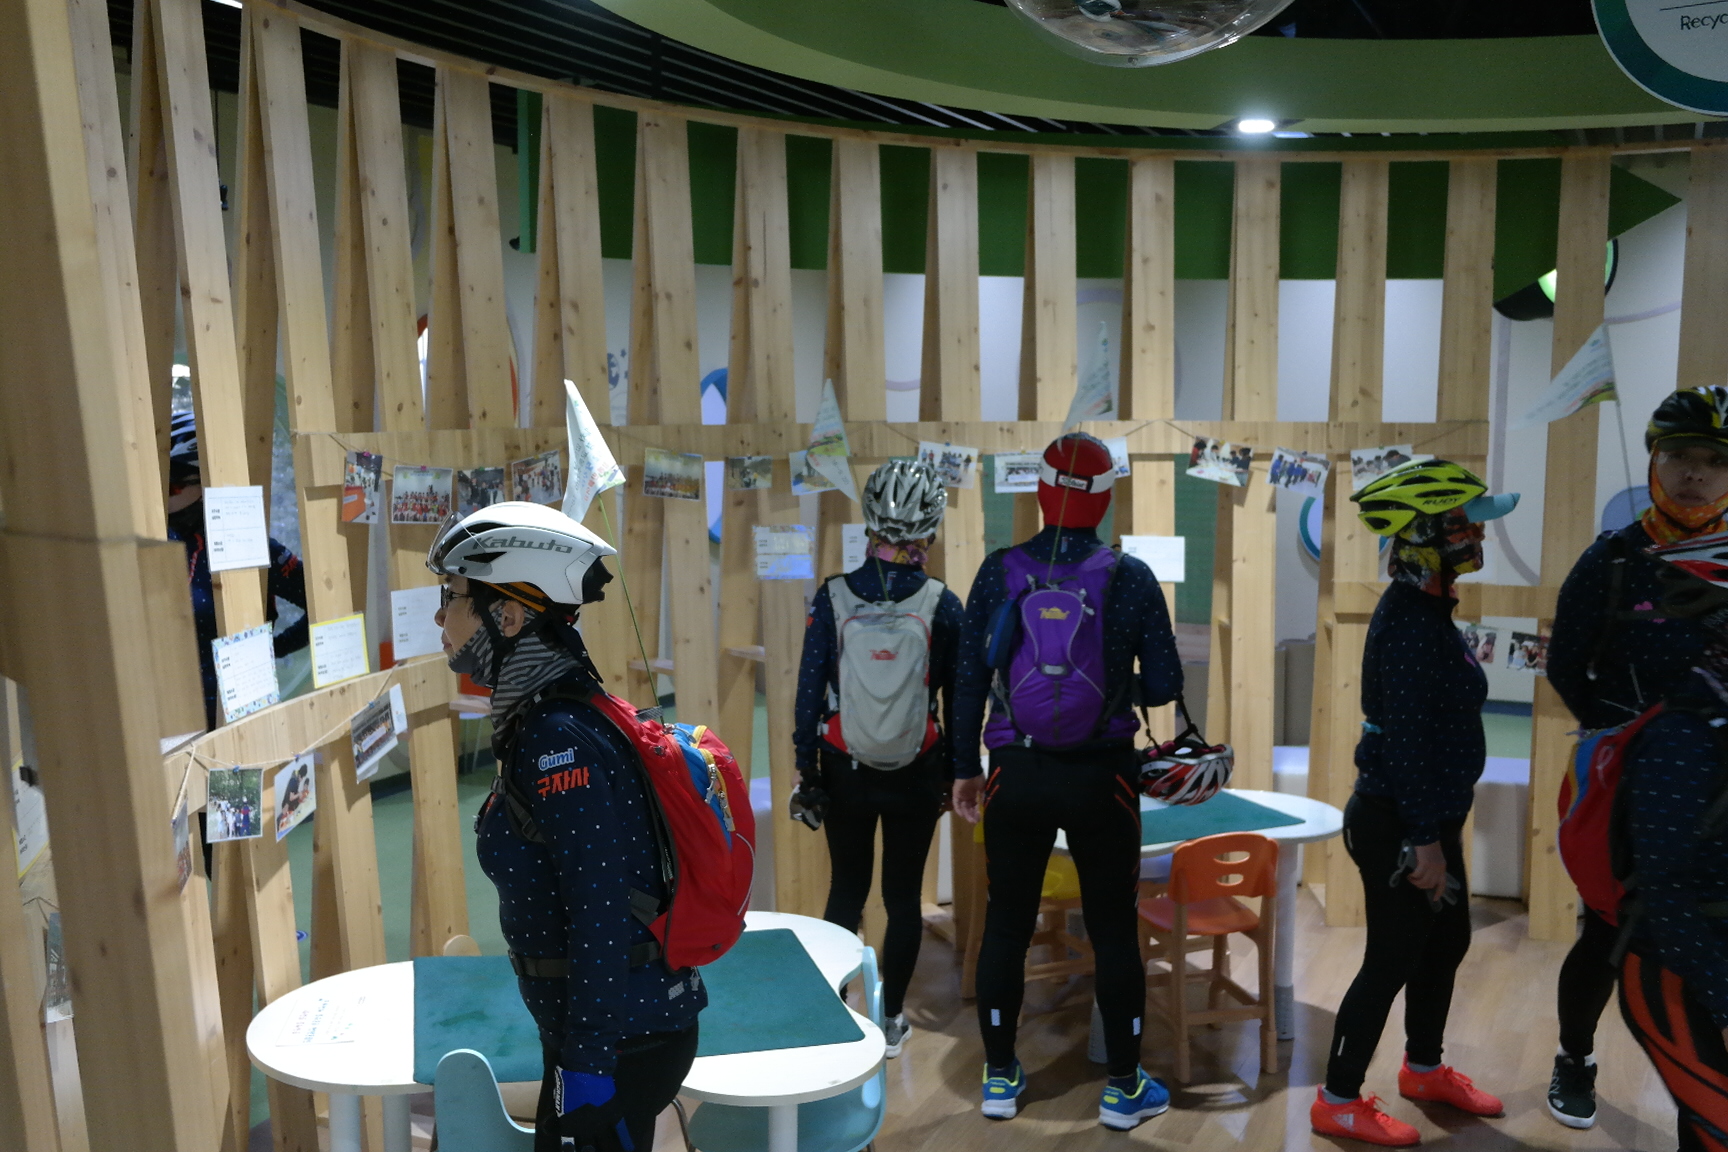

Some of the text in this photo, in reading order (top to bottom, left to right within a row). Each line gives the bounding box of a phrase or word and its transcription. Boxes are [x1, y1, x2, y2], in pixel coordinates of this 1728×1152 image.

[473, 536, 573, 554] Kabuto
[538, 748, 575, 771] Gumi
[537, 766, 591, 797] 구자사
